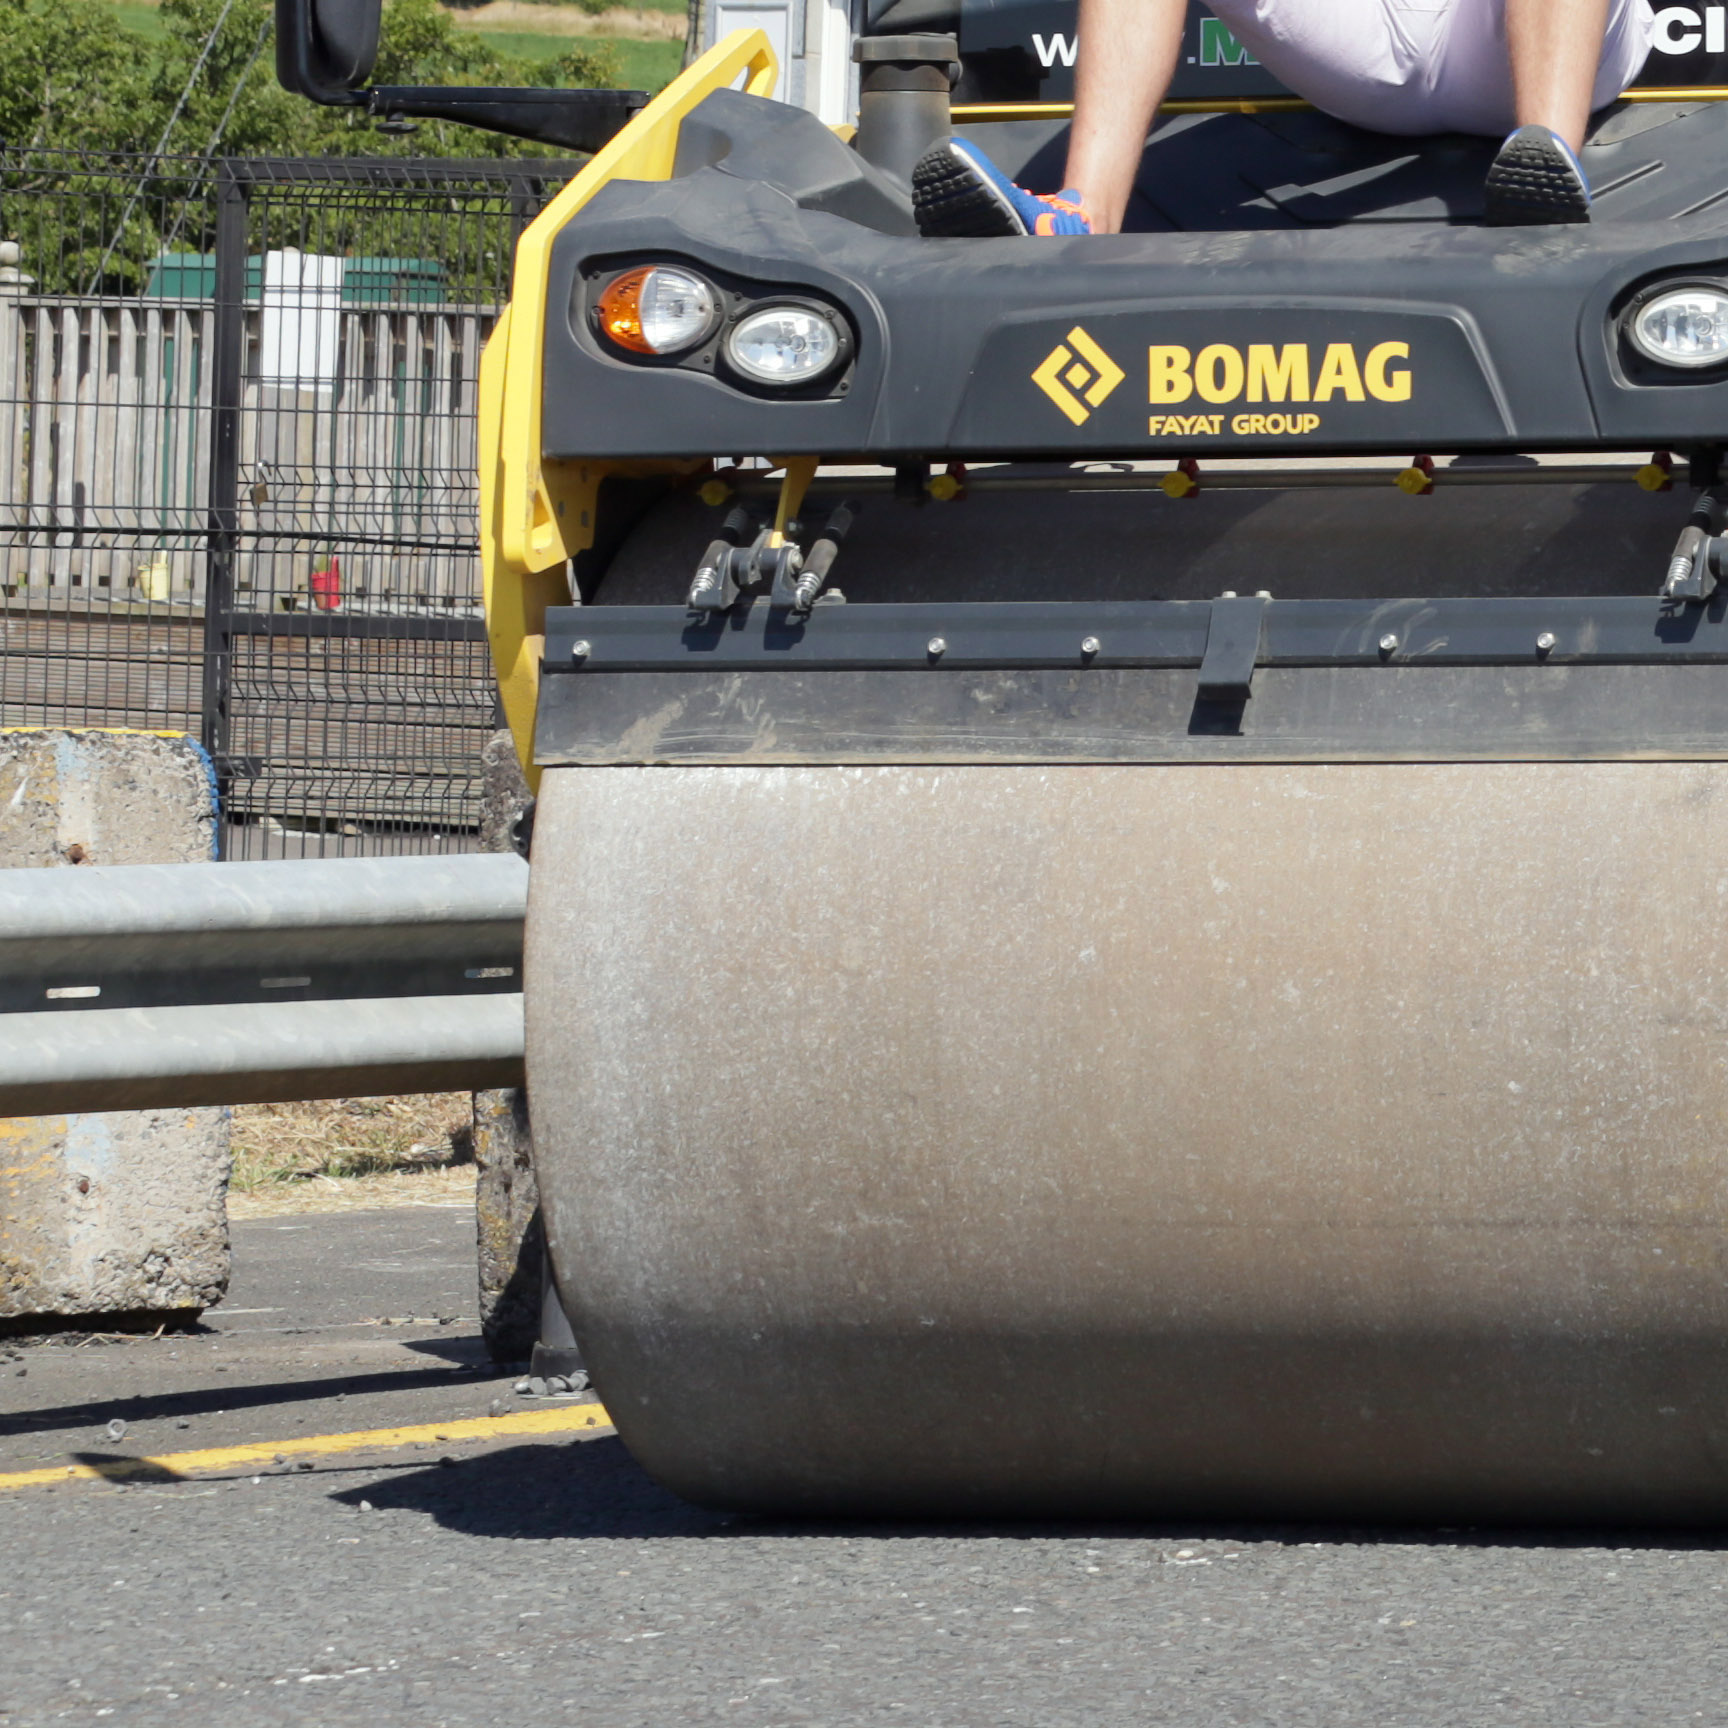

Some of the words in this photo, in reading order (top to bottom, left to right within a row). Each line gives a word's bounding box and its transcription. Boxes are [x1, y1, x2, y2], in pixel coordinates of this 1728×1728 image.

[1148, 341, 1413, 404] BOMAG
[1148, 415, 1225, 436] FAYAT
[1231, 413, 1321, 435] GROUP
